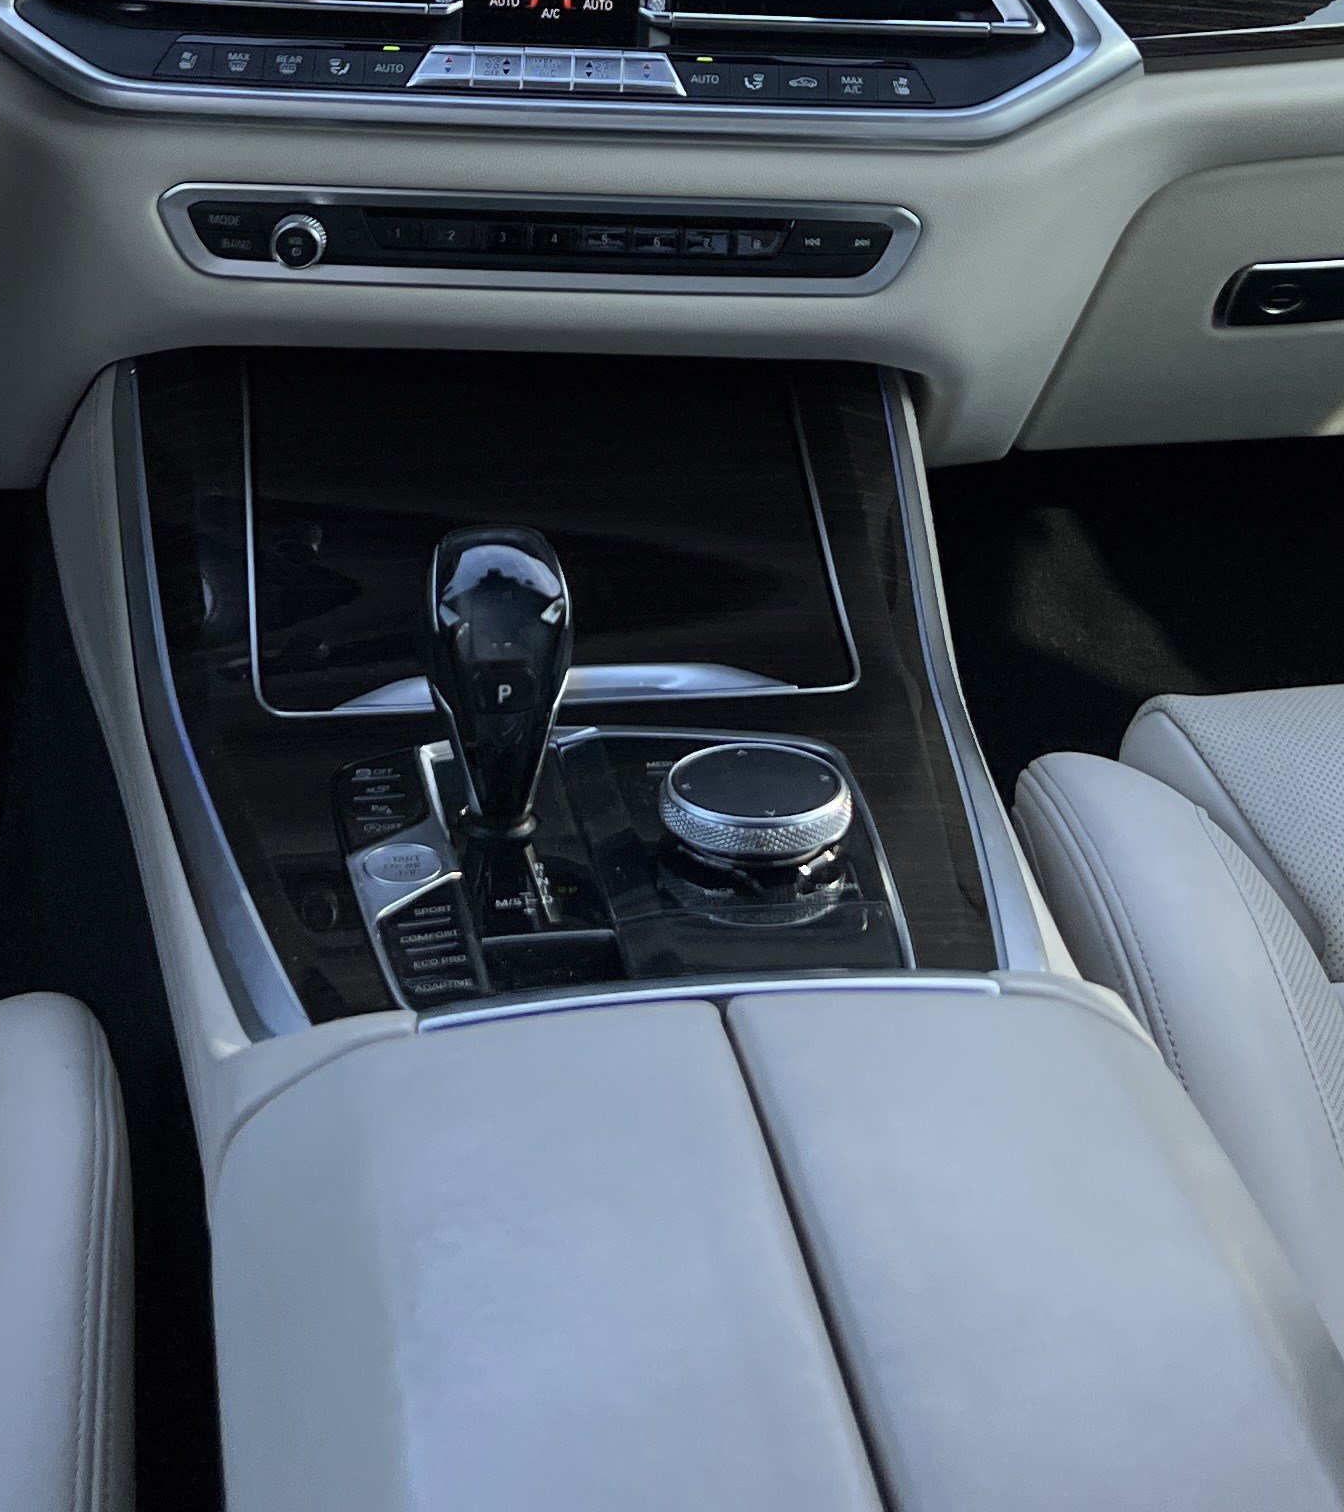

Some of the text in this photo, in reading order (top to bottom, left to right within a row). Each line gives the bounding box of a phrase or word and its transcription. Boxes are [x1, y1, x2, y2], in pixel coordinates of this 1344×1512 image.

[582, 0, 613, 12] AUTO
[540, 8, 561, 20] A/C
[227, 52, 250, 62] MAX
[275, 54, 303, 64] REAR
[374, 63, 404, 74] AUTO
[690, 74, 720, 85] AUTO
[841, 75, 863, 85] MAX
[498, 684, 512, 704] P
[414, 904, 451, 916] SPORT
[400, 929, 458, 944] COMFORT
[413, 954, 467, 970] ECO PRO
